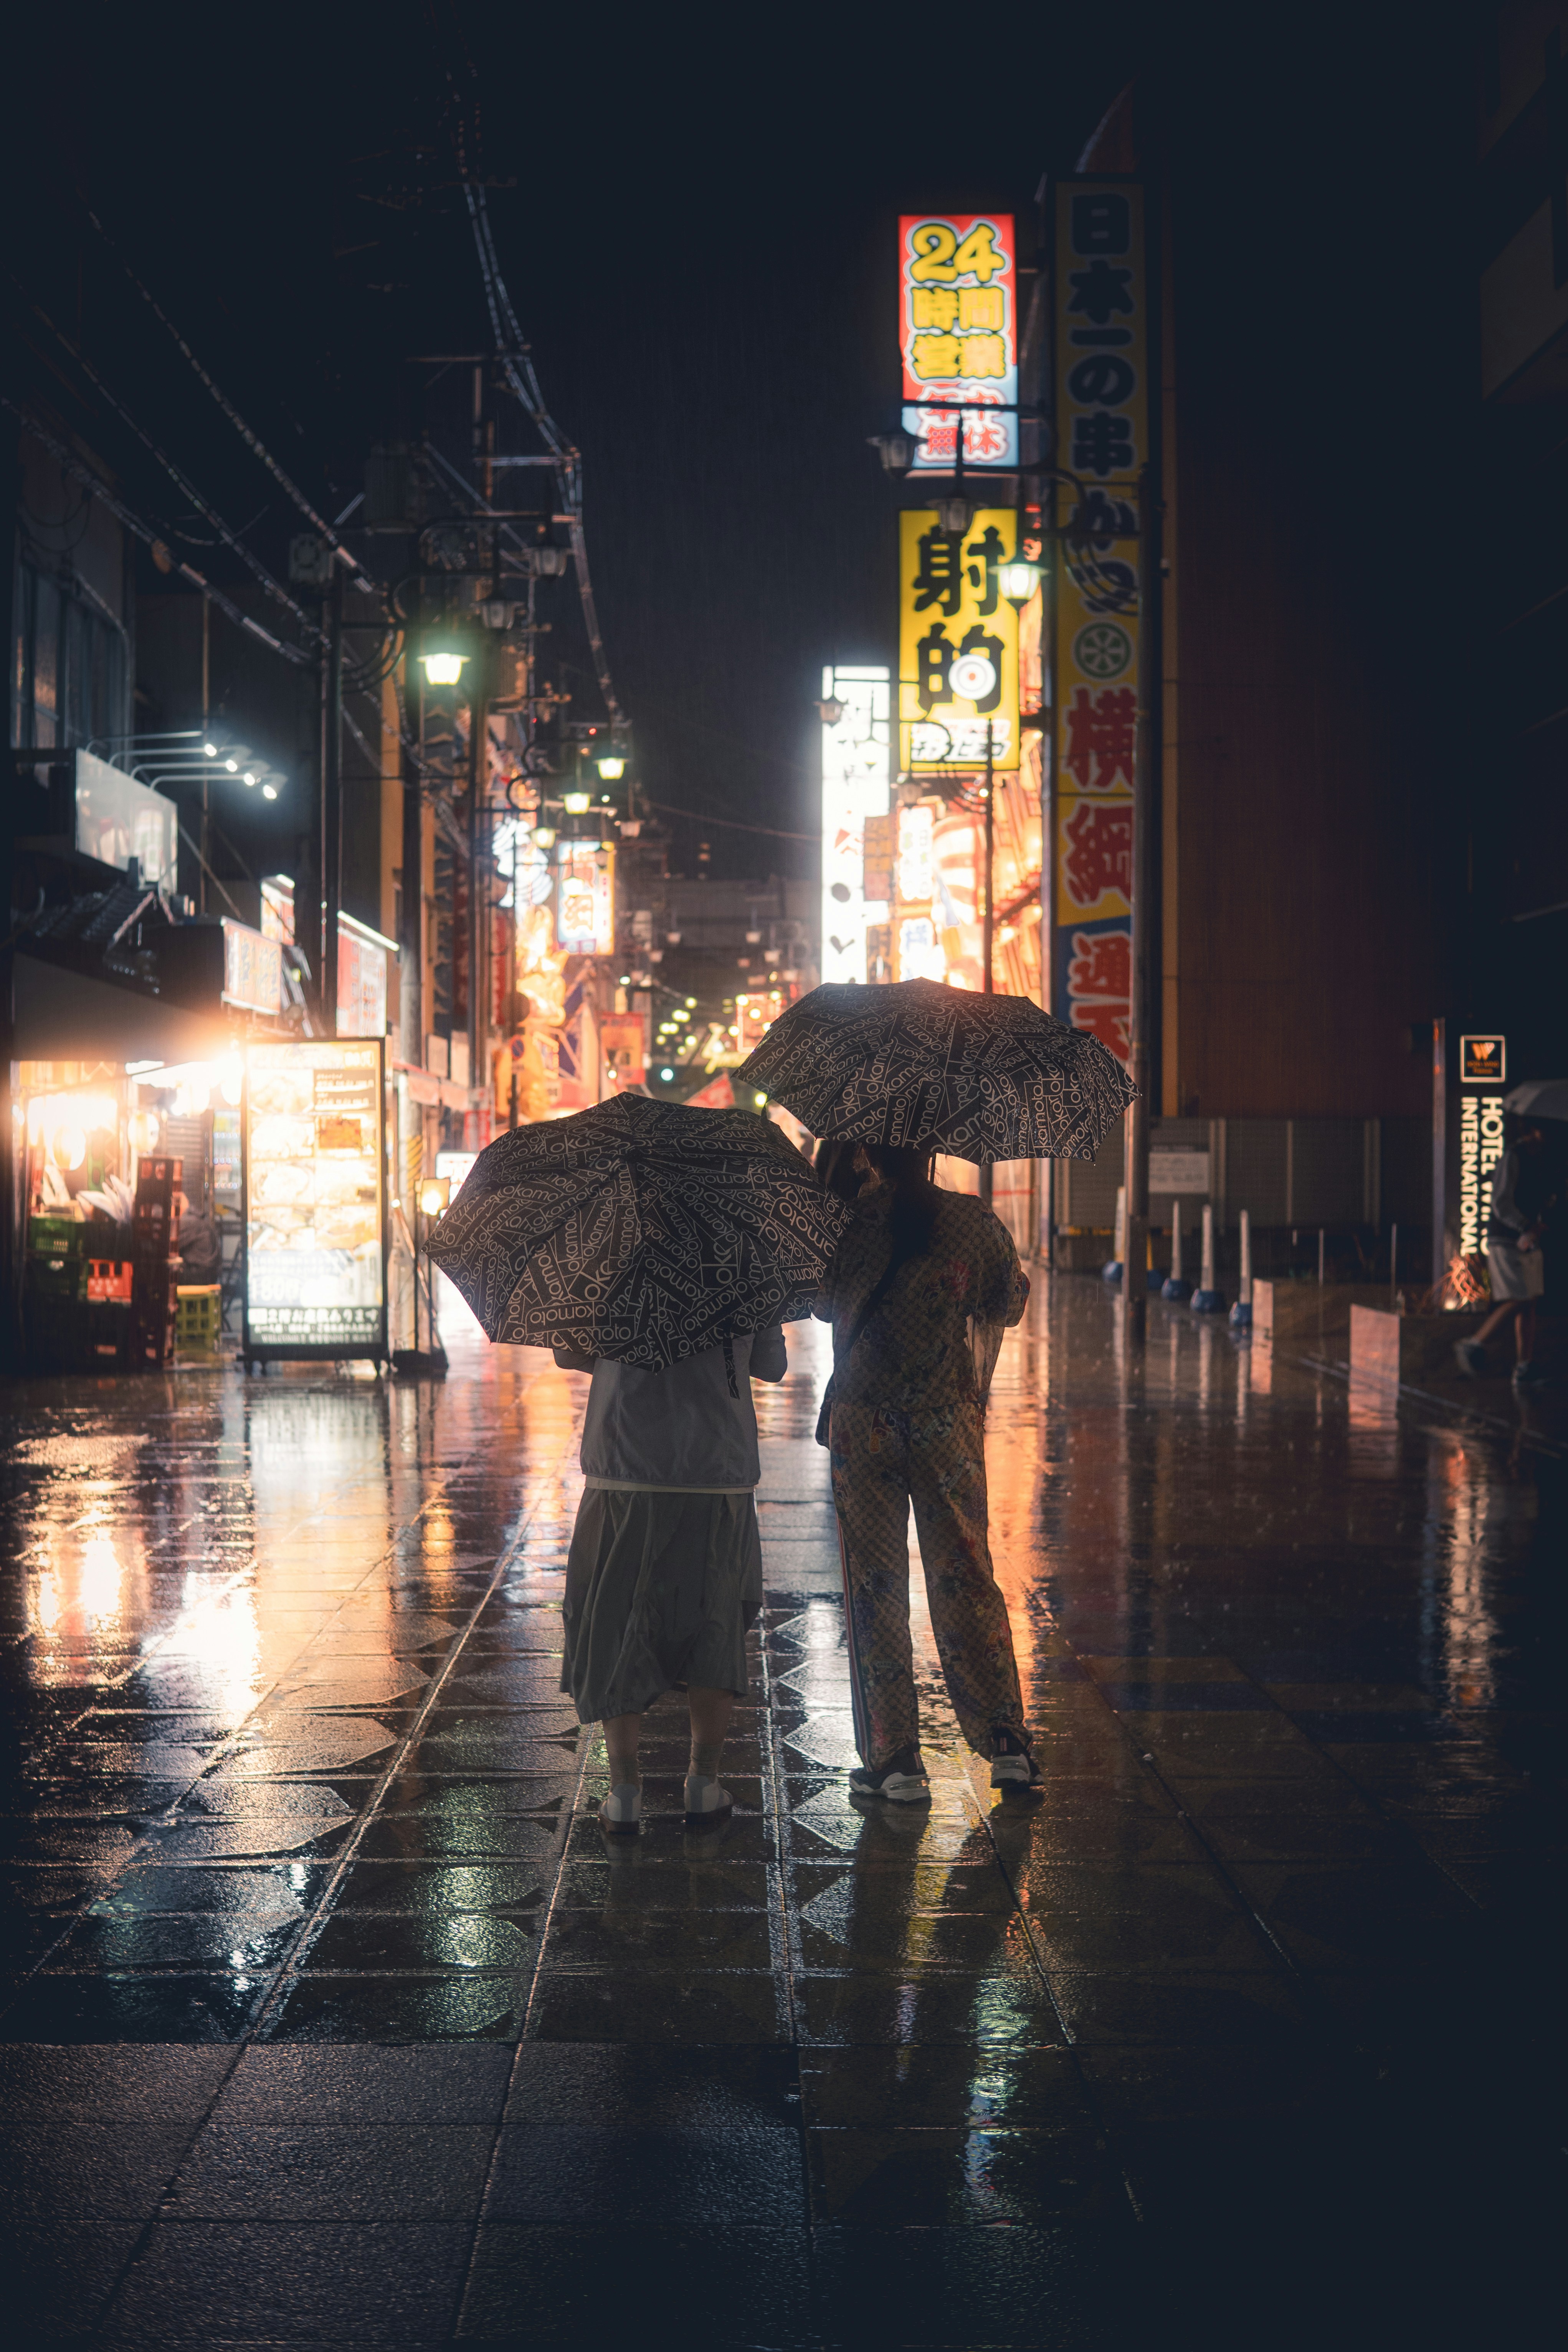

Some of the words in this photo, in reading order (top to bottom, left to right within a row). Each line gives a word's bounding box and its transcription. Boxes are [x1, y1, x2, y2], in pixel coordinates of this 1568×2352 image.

[911, 225, 1005, 283] 24
[912, 287, 1004, 331] 時間
[912, 334, 1006, 378] 営業
[913, 525, 1005, 714] 射的
[815, 1017, 879, 1054] okamoto
[820, 1028, 881, 1070] okamoto
[1480, 1097, 1504, 1176] HOTEL
[1461, 1097, 1478, 1257] INTERNATIONAL
[617, 1207, 636, 1268] okamoto
[684, 1193, 738, 1242] okamoto
[483, 1257, 497, 1332] okamoto
[530, 1304, 607, 1326] okamoto
[684, 1282, 748, 1331] okamoto
